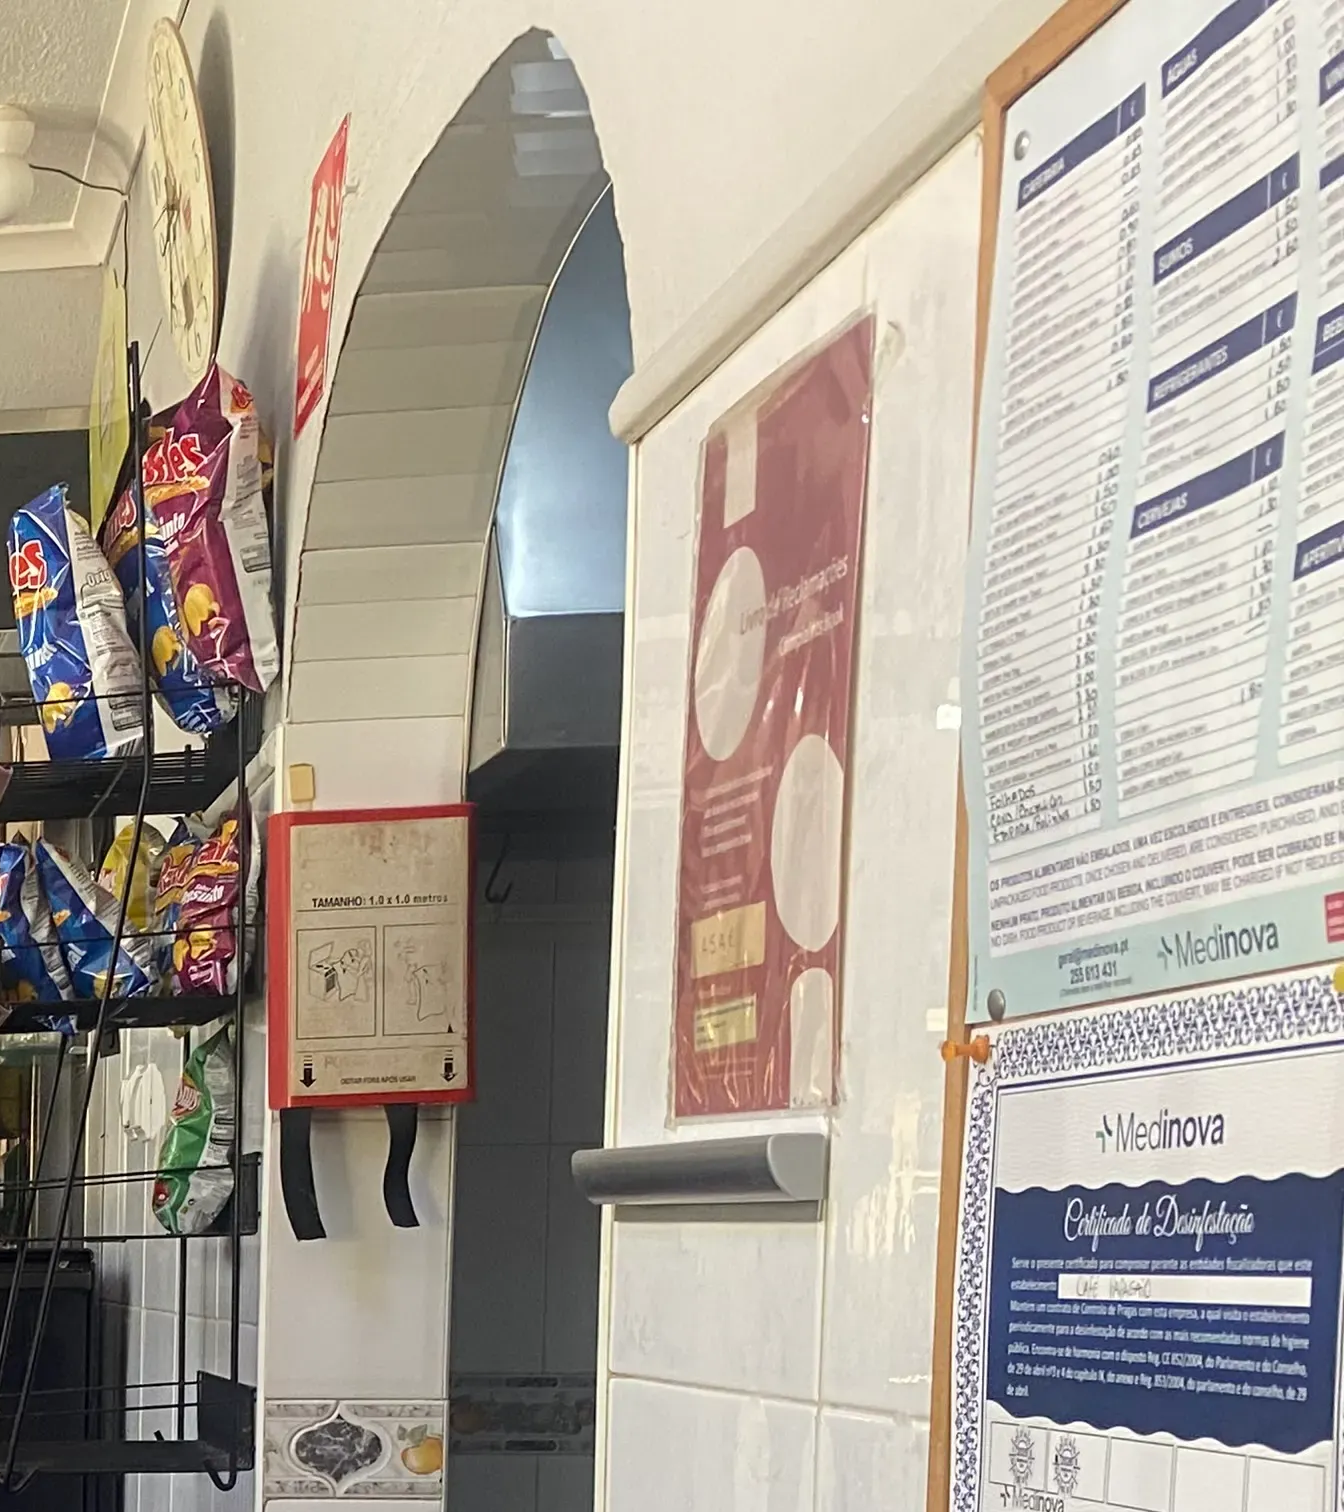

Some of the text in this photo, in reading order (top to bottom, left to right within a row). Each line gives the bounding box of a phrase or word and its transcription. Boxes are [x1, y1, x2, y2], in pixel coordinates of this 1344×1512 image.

[1137, 492, 1189, 529] CERVEJAS
[1232, 852, 1256, 869] PODE
[1257, 847, 1275, 863] SER
[1276, 835, 1322, 858] COBRADO
[312, 896, 367, 908] TAMANHO:
[370, 895, 384, 905] 1.0
[395, 894, 410, 904] 1.0
[413, 894, 448, 904] metros
[1175, 921, 1280, 969] Medinova
[1116, 1112, 1225, 1153] Medinova
[1064, 1194, 1255, 1252] Certificado de Desinfestação
[1065, 1257, 1098, 1269] certificado
[1099, 1260, 1113, 1271] para
[1277, 1260, 1293, 1273] que
[1294, 1259, 1312, 1272] este
